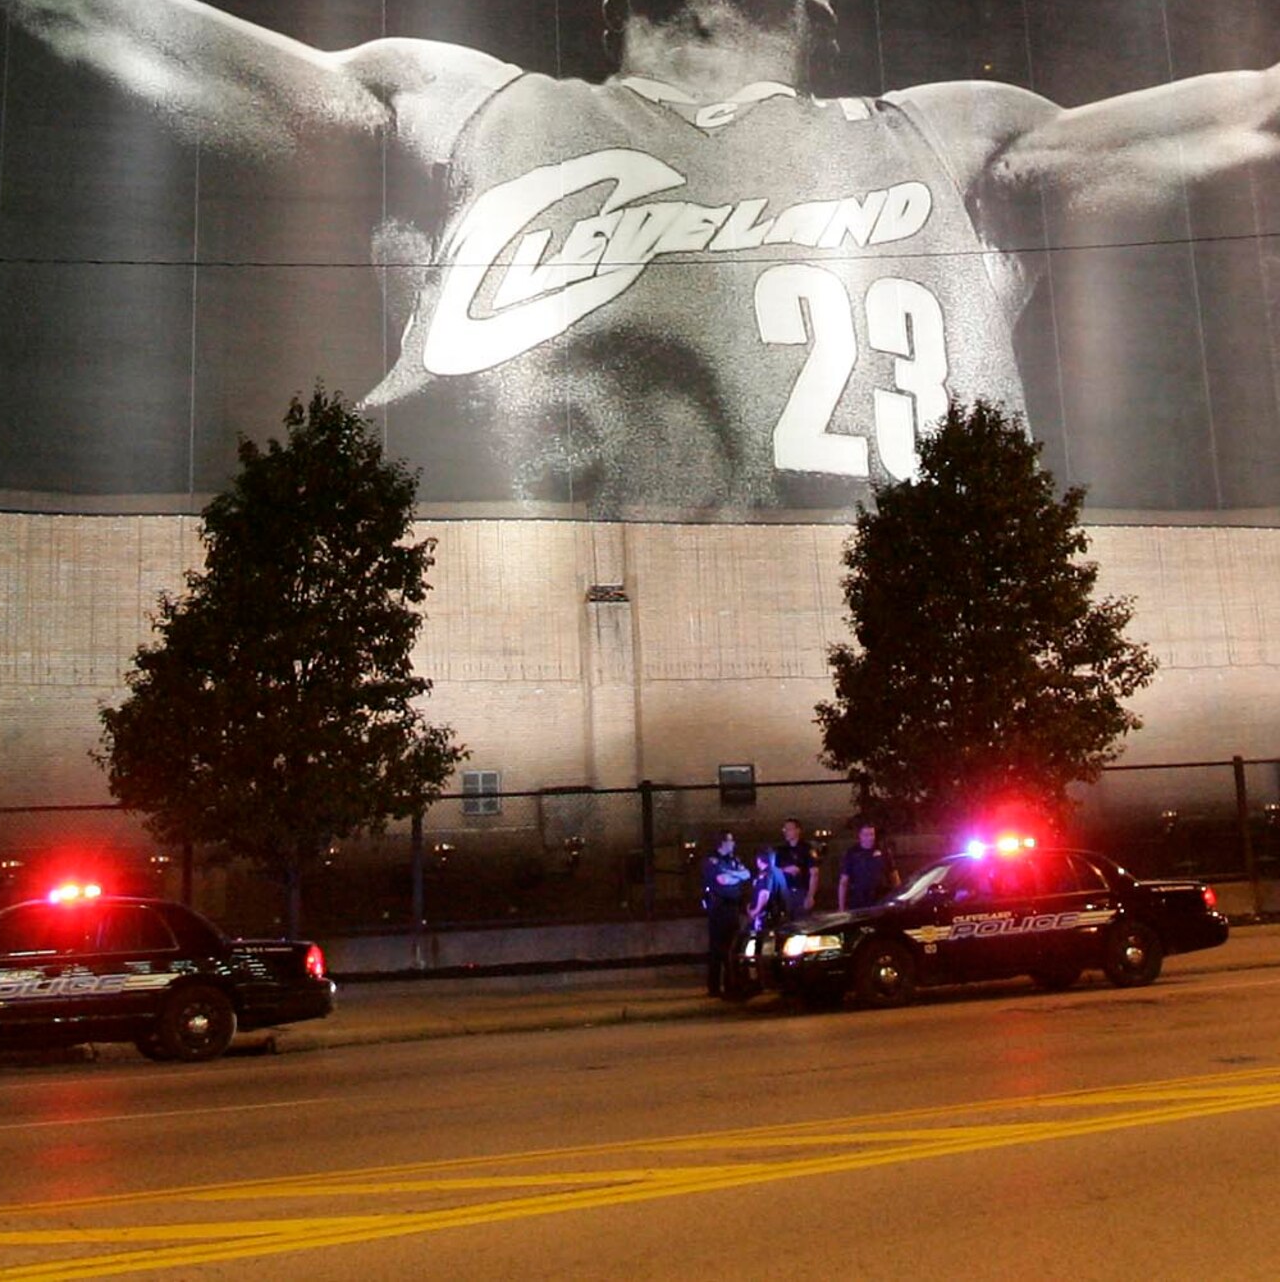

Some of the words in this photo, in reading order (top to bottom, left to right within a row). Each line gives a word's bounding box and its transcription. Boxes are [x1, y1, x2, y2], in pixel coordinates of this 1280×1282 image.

[423, 148, 932, 377] CLEVELAND
[754, 263, 950, 486] 23
[949, 912, 1081, 940] POLICE
